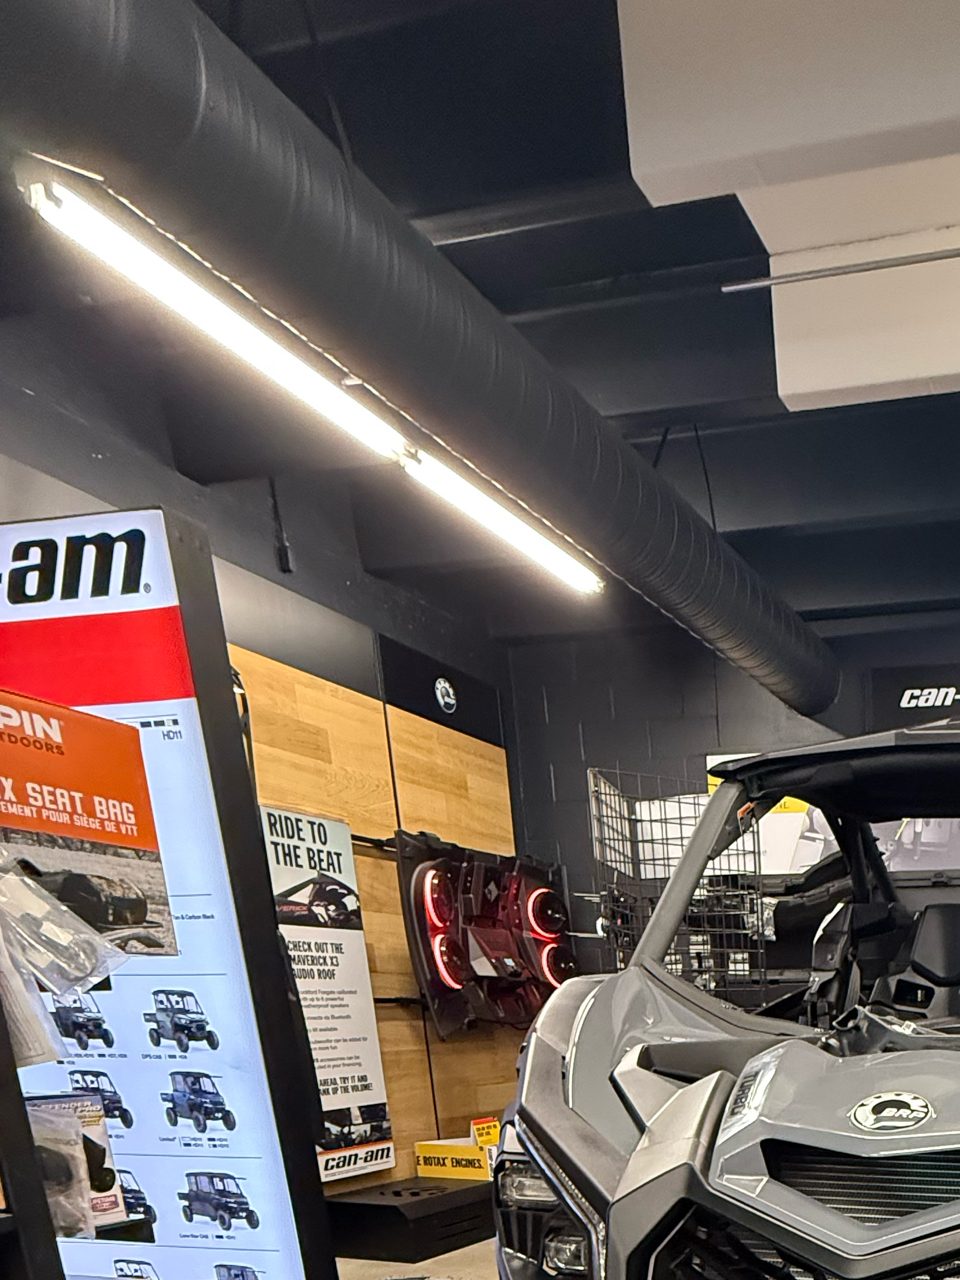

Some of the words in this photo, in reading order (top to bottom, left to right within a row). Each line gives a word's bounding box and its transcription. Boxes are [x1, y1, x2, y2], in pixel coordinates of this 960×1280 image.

[0, 528, 146, 605] am
[162, 730, 183, 741] HD11
[0, 776, 17, 802] X
[26, 782, 83, 815] SEAT
[93, 795, 136, 825] BAG
[41, 808, 72, 825] POUR
[73, 813, 102, 830] SIÈGE
[104, 820, 118, 833] DE
[120, 823, 138, 837] VTT
[267, 812, 306, 842] RIDE
[308, 820, 328, 846] TO
[271, 841, 304, 869] THE
[307, 847, 342, 874] BEAT
[288, 940, 313, 953] CHECK
[314, 942, 329, 954] OUT
[329, 943, 345, 954] THE
[329, 956, 340, 967] X3
[317, 969, 336, 980] ROOF
[357, 1074, 368, 1083] AND
[331, 1086, 339, 1095] UP
[340, 1085, 350, 1094] THE
[879, 1107, 926, 1119] BRP
[324, 1146, 391, 1171] can-am
[423, 1156, 448, 1167] ROTAX
[451, 1157, 484, 1169] ENGINES.
